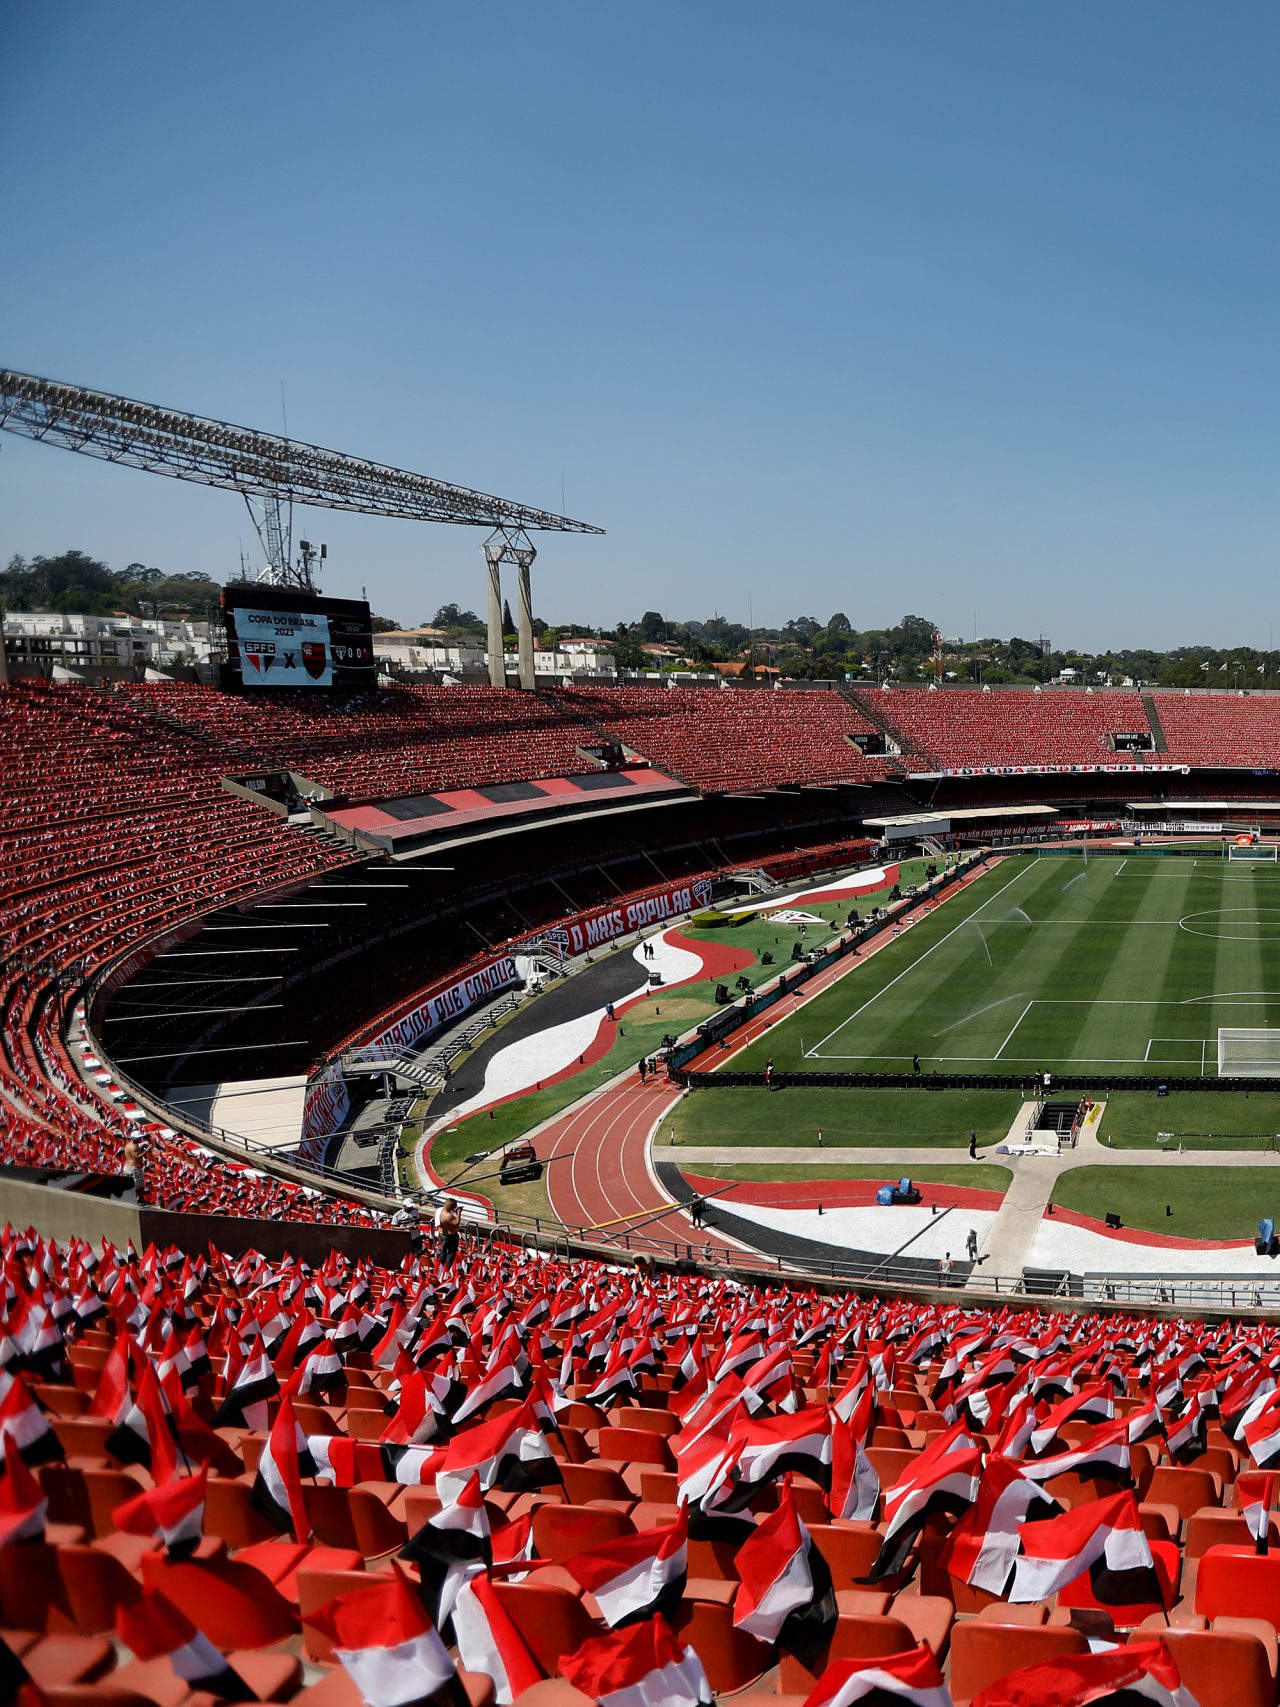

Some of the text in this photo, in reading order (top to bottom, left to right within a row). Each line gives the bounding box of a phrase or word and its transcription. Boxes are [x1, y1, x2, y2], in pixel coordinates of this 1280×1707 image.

[248, 614, 317, 628] COPA DO BRASIL
[275, 627, 295, 636] 2023
[246, 643, 275, 653] SPFC
[283, 652, 296, 669] X
[1069, 823, 1089, 831] NUNCA
[694, 881, 710, 895] SPFC
[570, 887, 692, 952] O MAIS POPULAR
[547, 931, 568, 942] SPFC
[434, 986, 465, 1023] QUE
